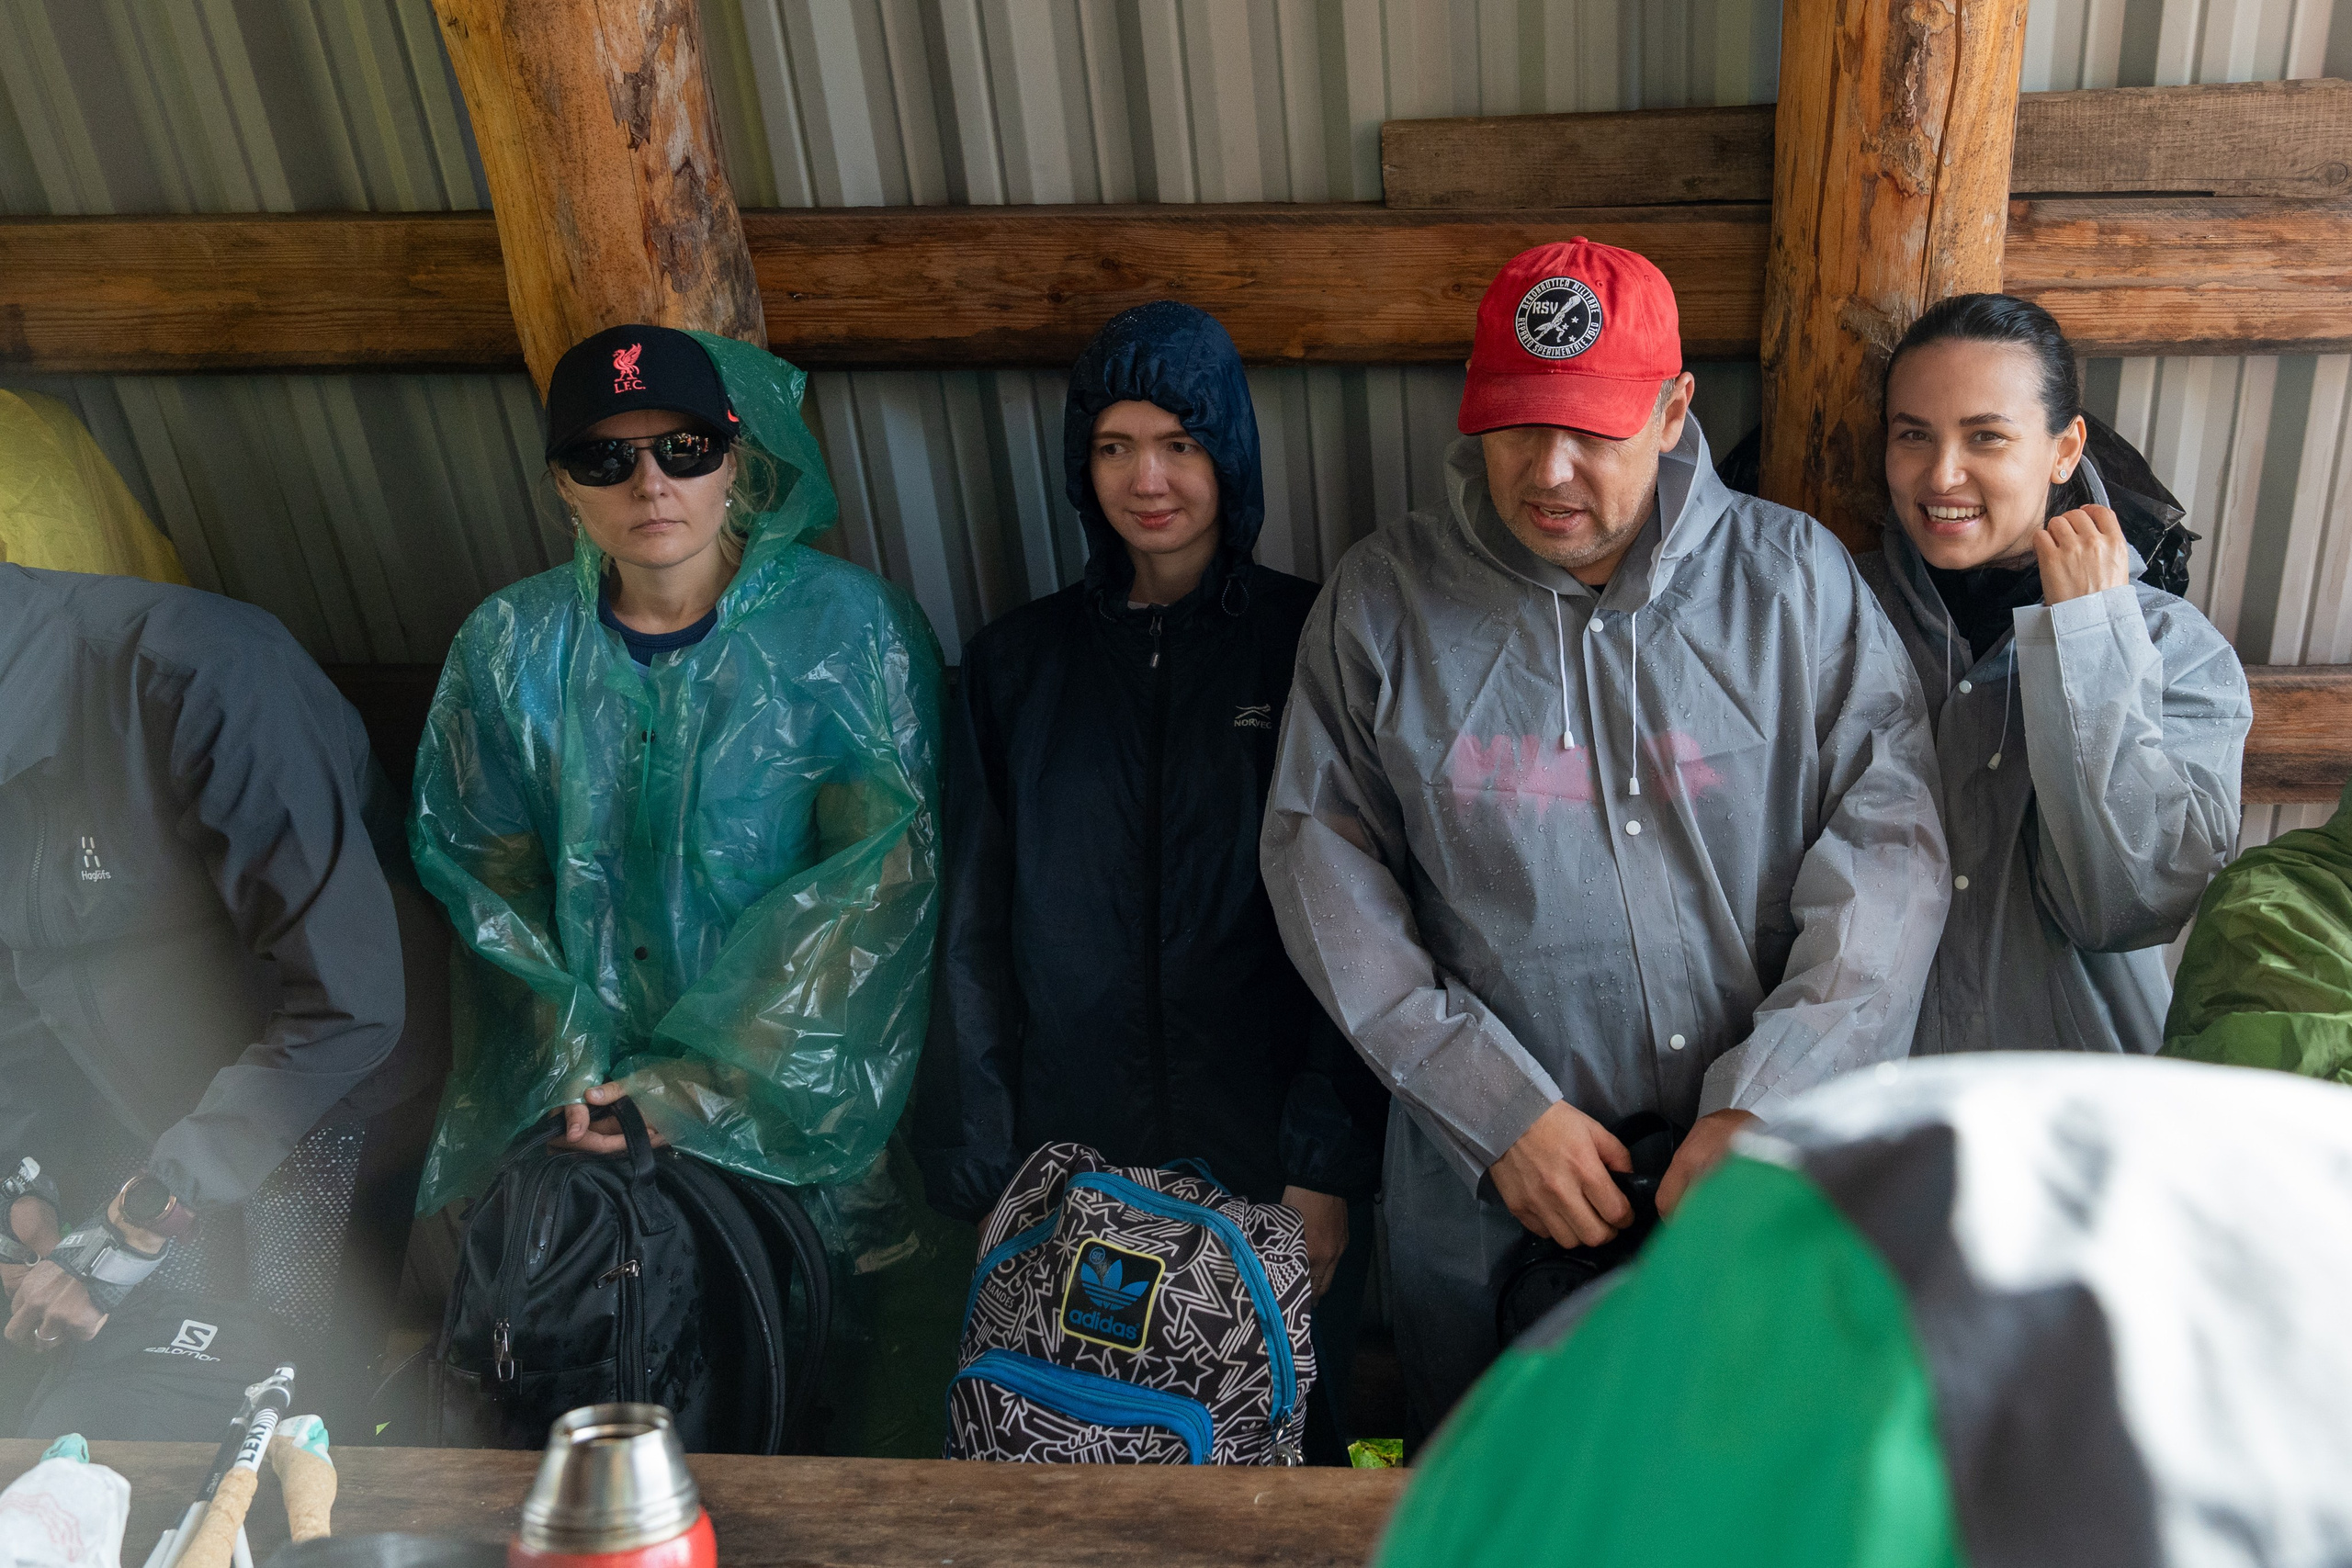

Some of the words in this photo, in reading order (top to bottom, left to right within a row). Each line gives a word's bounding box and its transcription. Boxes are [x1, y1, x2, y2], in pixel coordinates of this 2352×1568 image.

[1521, 279, 1570, 310] AERONAUTICA
[1572, 282, 1600, 314] MILITARE
[1532, 301, 1559, 315] RSV
[1517, 317, 1534, 348] REPARTO
[1532, 340, 1589, 356] SPERIMENTALE
[1585, 322, 1600, 342] VOLO
[985, 1280, 1015, 1309] BANDES
[1069, 1309, 1138, 1340] adidas
[236, 1423, 268, 1463] LEKI
